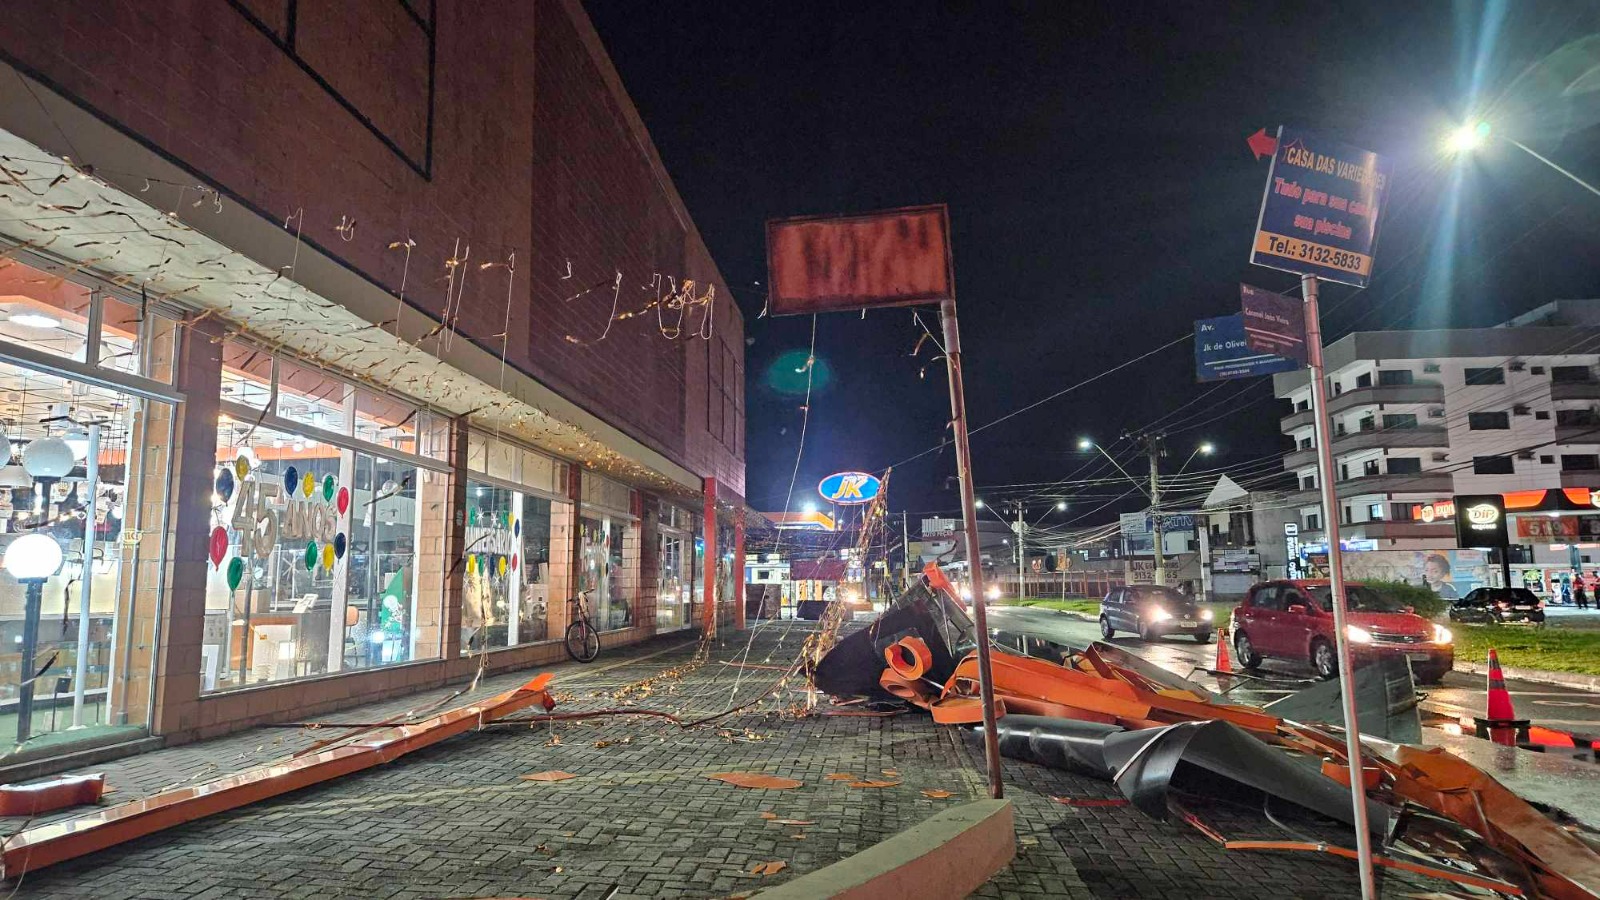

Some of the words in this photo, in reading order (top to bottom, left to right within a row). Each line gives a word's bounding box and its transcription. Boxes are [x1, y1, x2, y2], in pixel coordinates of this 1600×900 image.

[1287, 147, 1315, 170] CASA
[1316, 154, 1336, 174] DAS
[1269, 236, 1296, 256] Tel.:
[1298, 243, 1362, 270] 3132-5833
[1201, 324, 1215, 332] Av.
[1214, 342, 1223, 351] de
[1225, 340, 1247, 349] Olivei
[831, 475, 868, 499] JK
[231, 480, 279, 559] 45
[282, 500, 338, 541] ANOS
